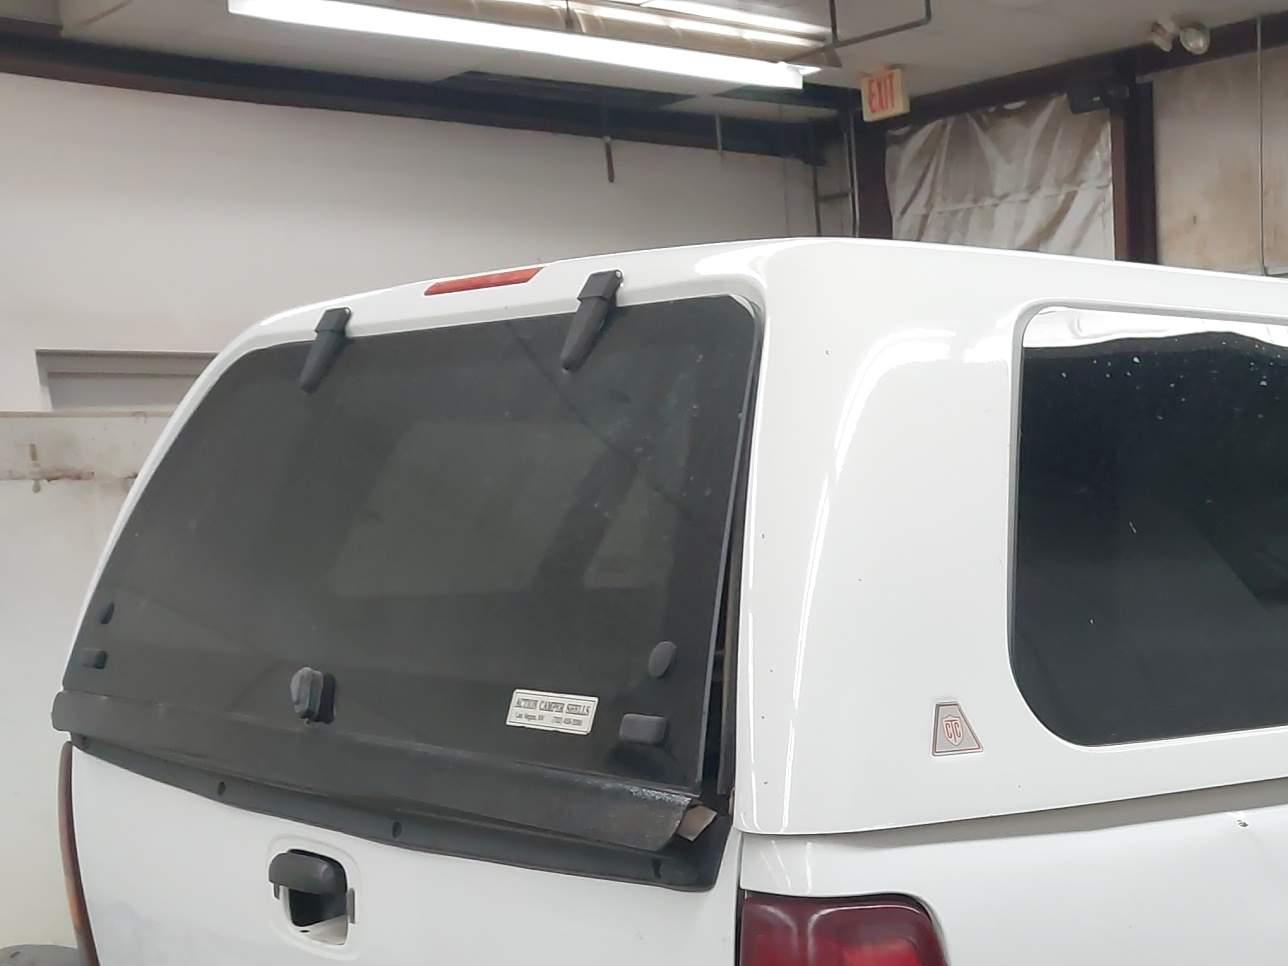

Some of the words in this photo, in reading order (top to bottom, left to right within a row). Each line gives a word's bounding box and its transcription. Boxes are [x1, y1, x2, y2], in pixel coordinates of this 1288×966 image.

[868, 74, 896, 112] EXIT
[539, 700, 565, 713] CAMPER
[565, 703, 591, 716] SHELLS
